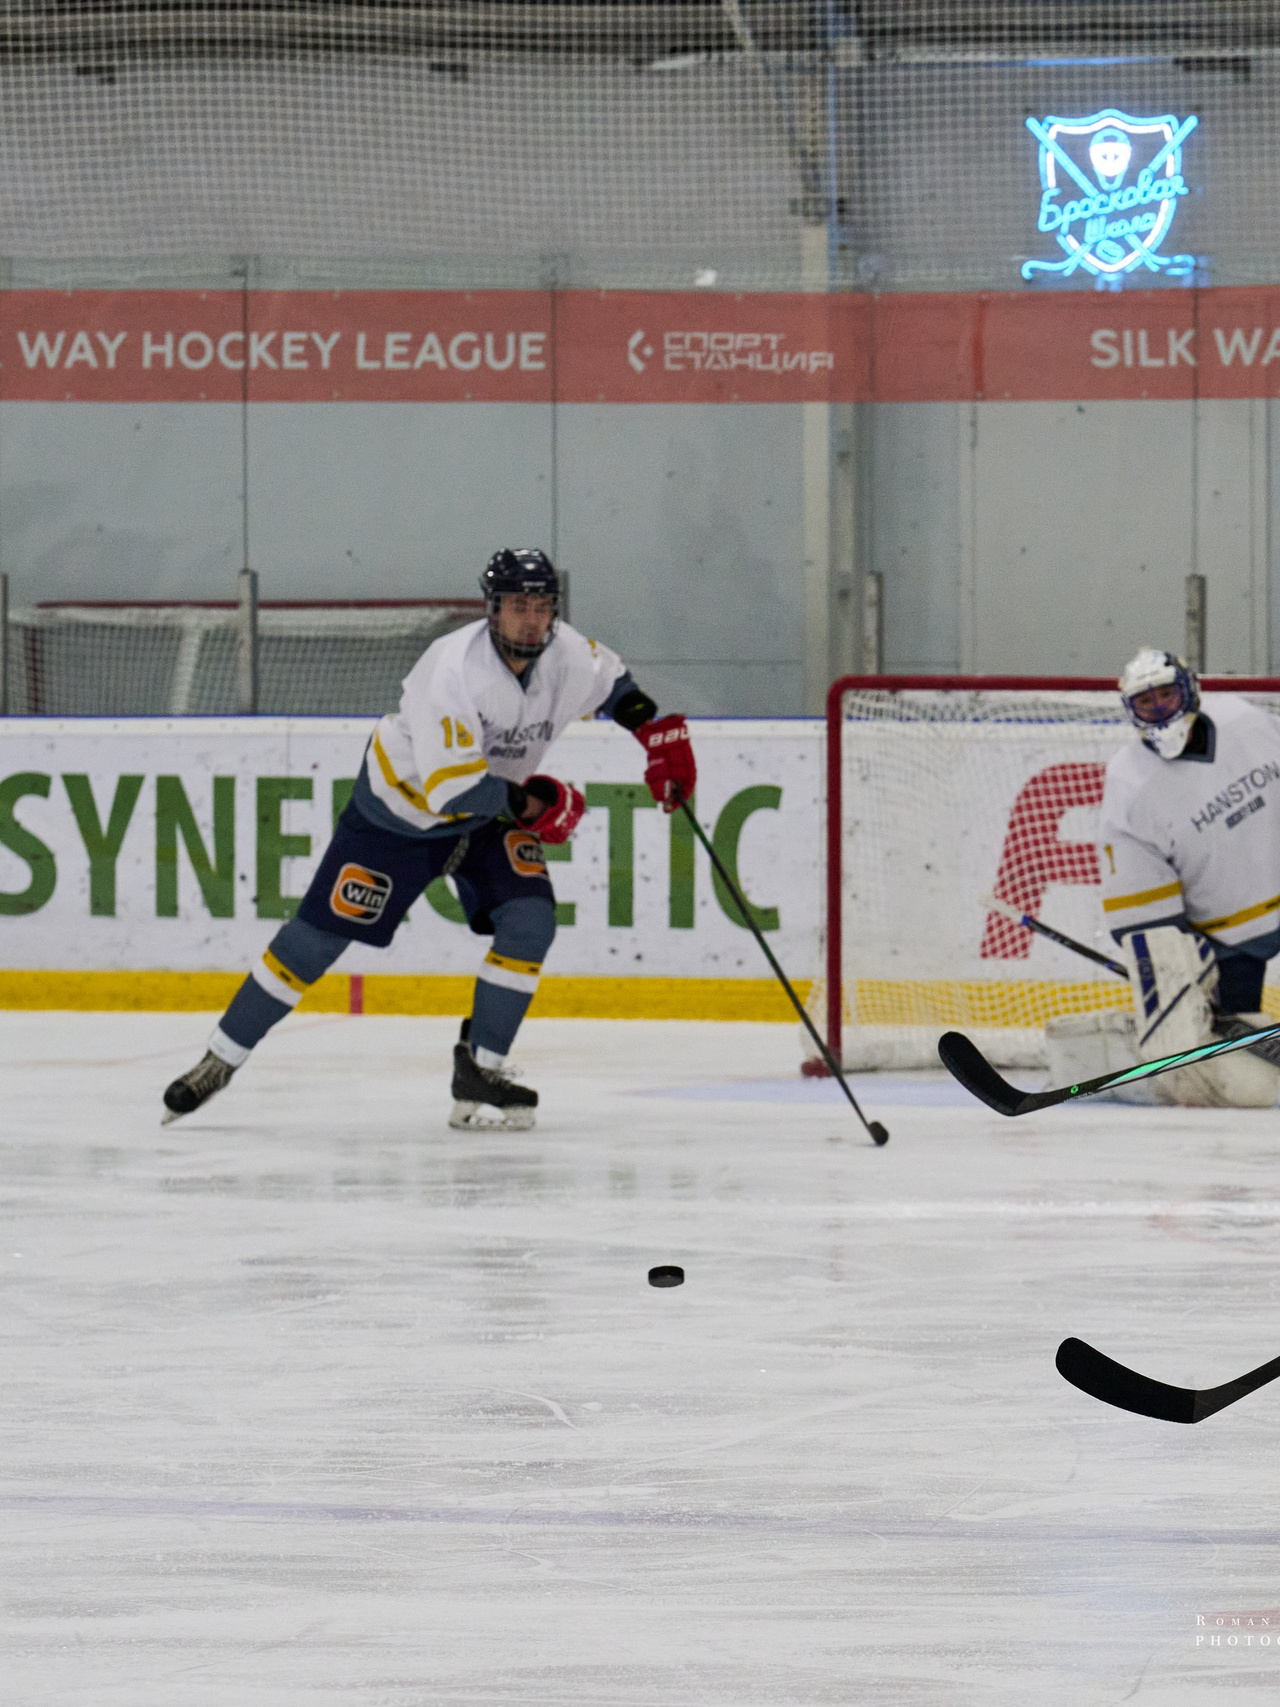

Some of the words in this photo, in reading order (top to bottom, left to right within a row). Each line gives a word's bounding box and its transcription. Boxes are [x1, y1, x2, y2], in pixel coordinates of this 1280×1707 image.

[17, 331, 127, 369] WAY
[143, 331, 341, 369] HOCKEY
[356, 331, 547, 369] LEAGUE
[664, 331, 785, 351] СПОРТ
[1090, 329, 1197, 368] SILK
[664, 351, 834, 373] СТАНЦИЯ
[649, 726, 688, 748] BAU
[0, 771, 783, 931] SYNETIC
[345, 880, 384, 910] Win
